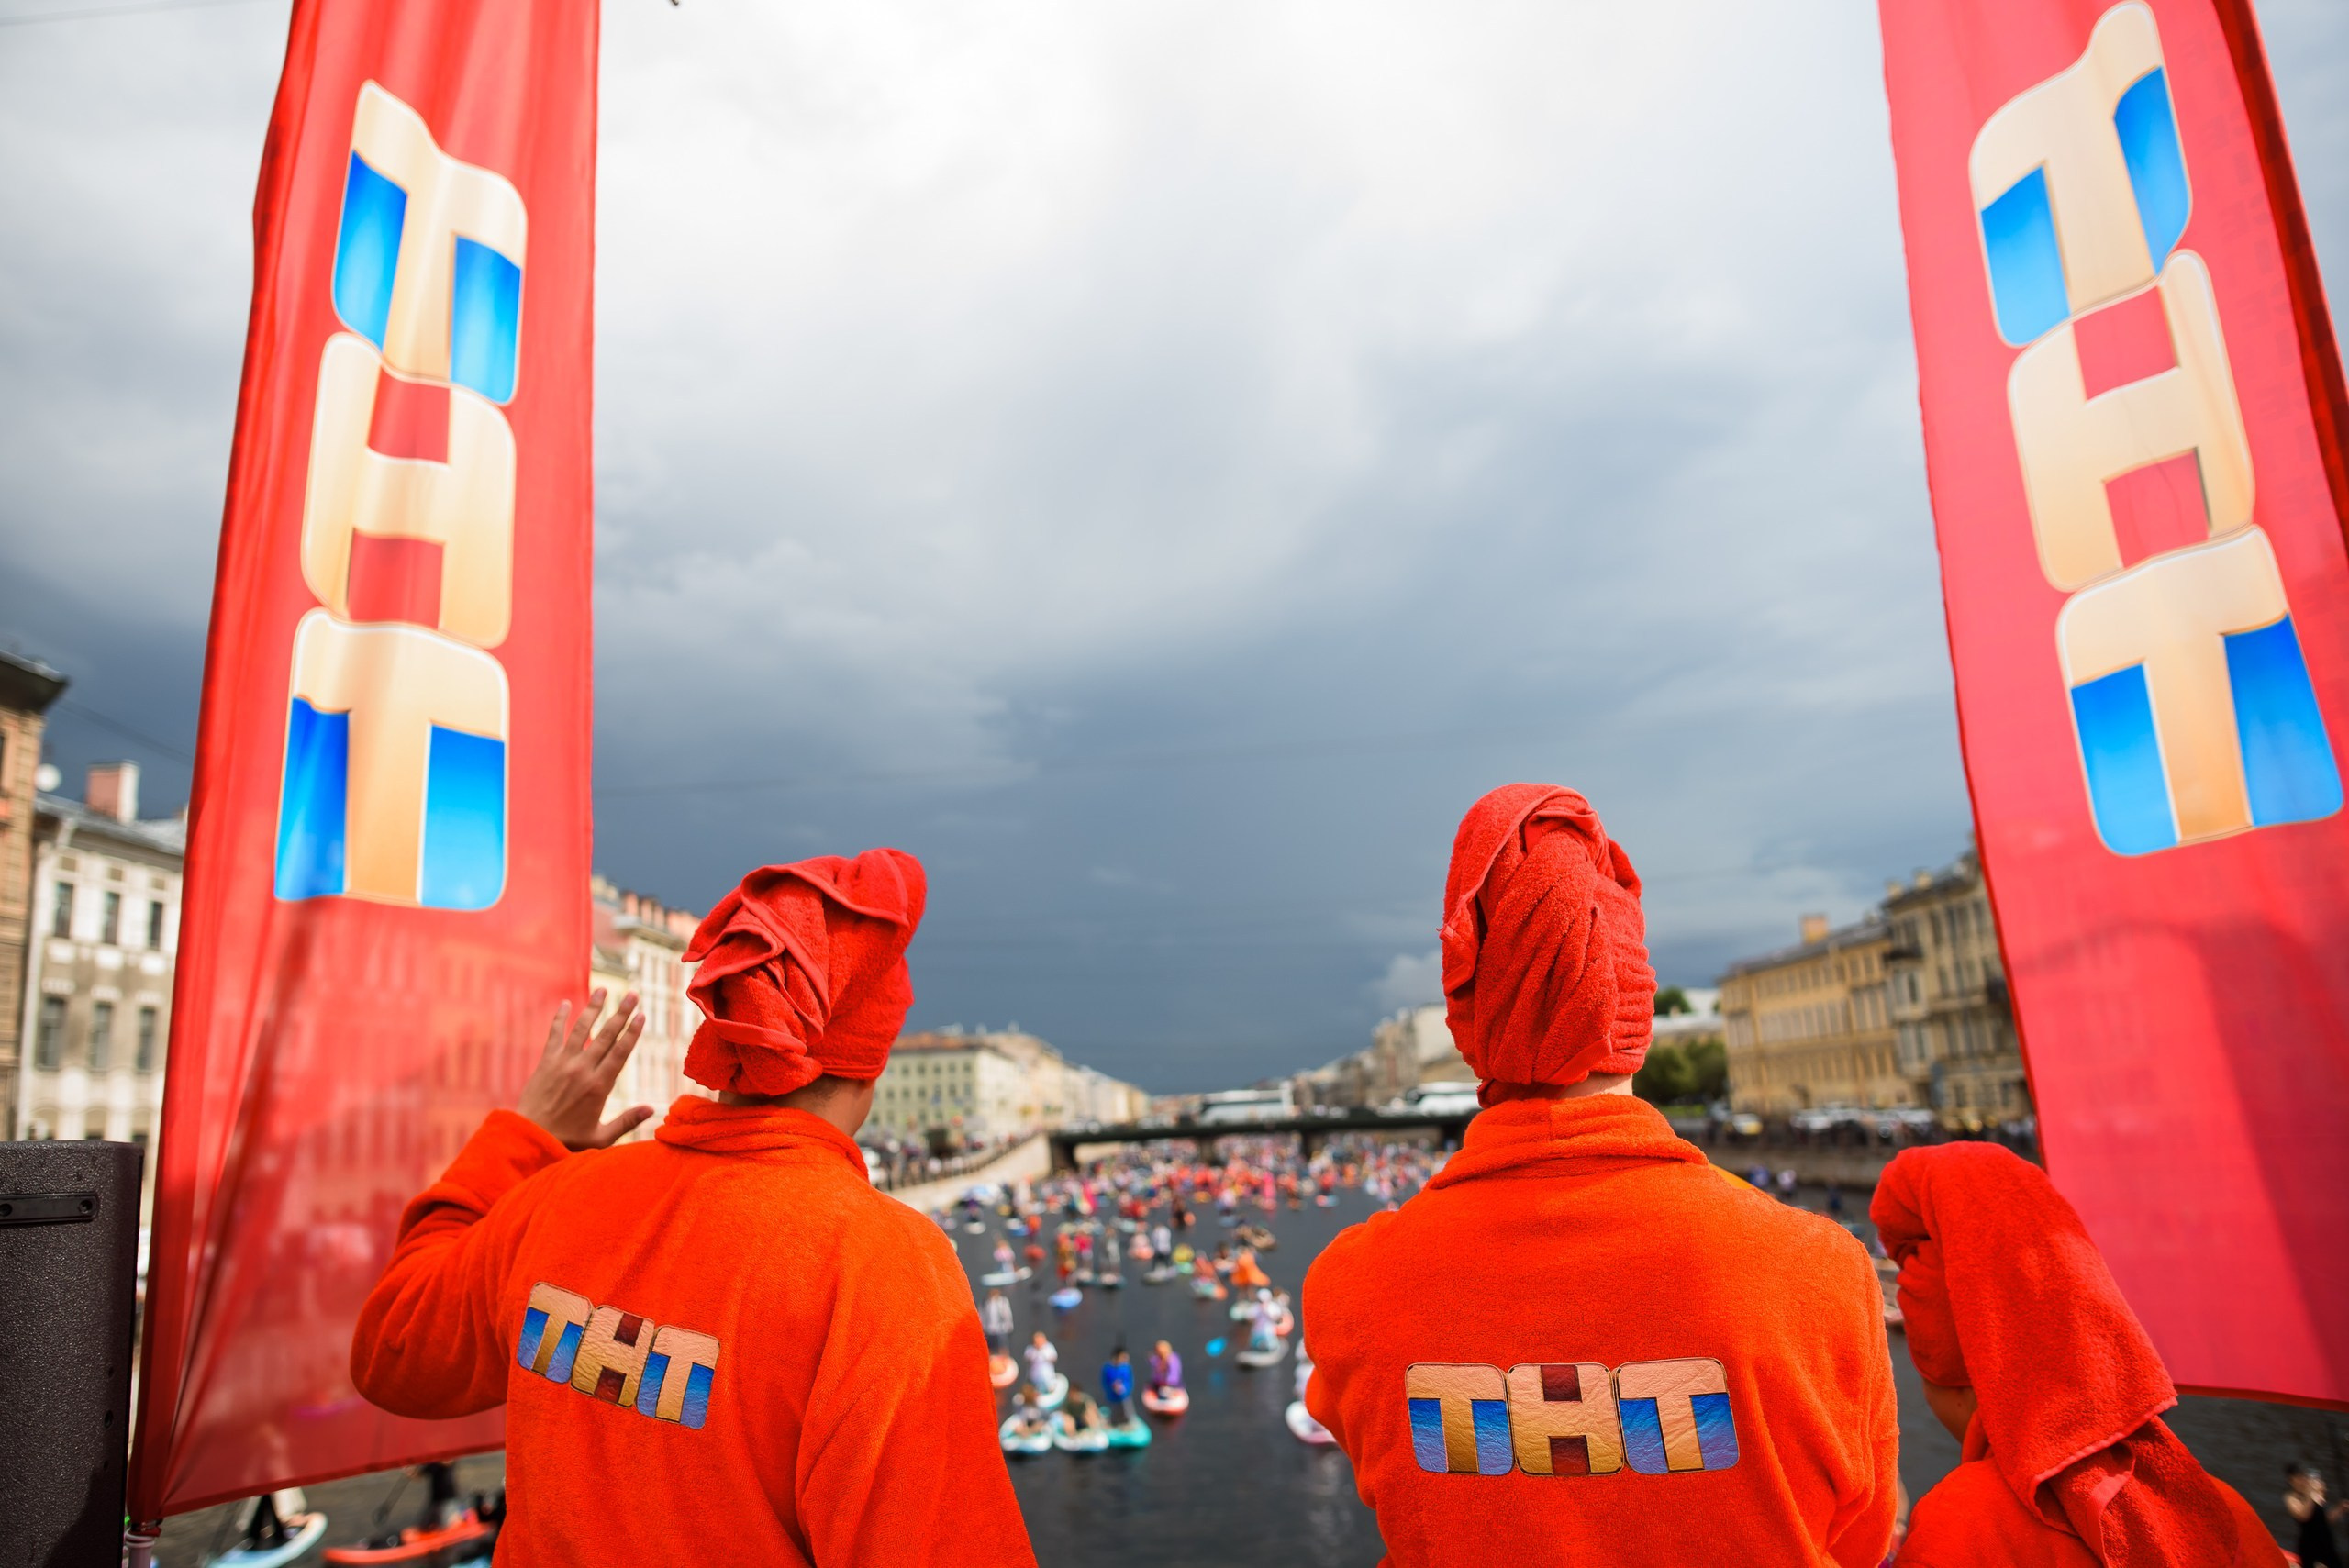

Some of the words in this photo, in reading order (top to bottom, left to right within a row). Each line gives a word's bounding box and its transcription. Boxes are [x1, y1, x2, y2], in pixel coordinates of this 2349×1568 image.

[273, 79, 528, 911] ТНТ
[1969, 0, 2344, 857] ТНТ
[518, 1282, 720, 1429] ТНТ
[1406, 1357, 1740, 1476] ТНТ
